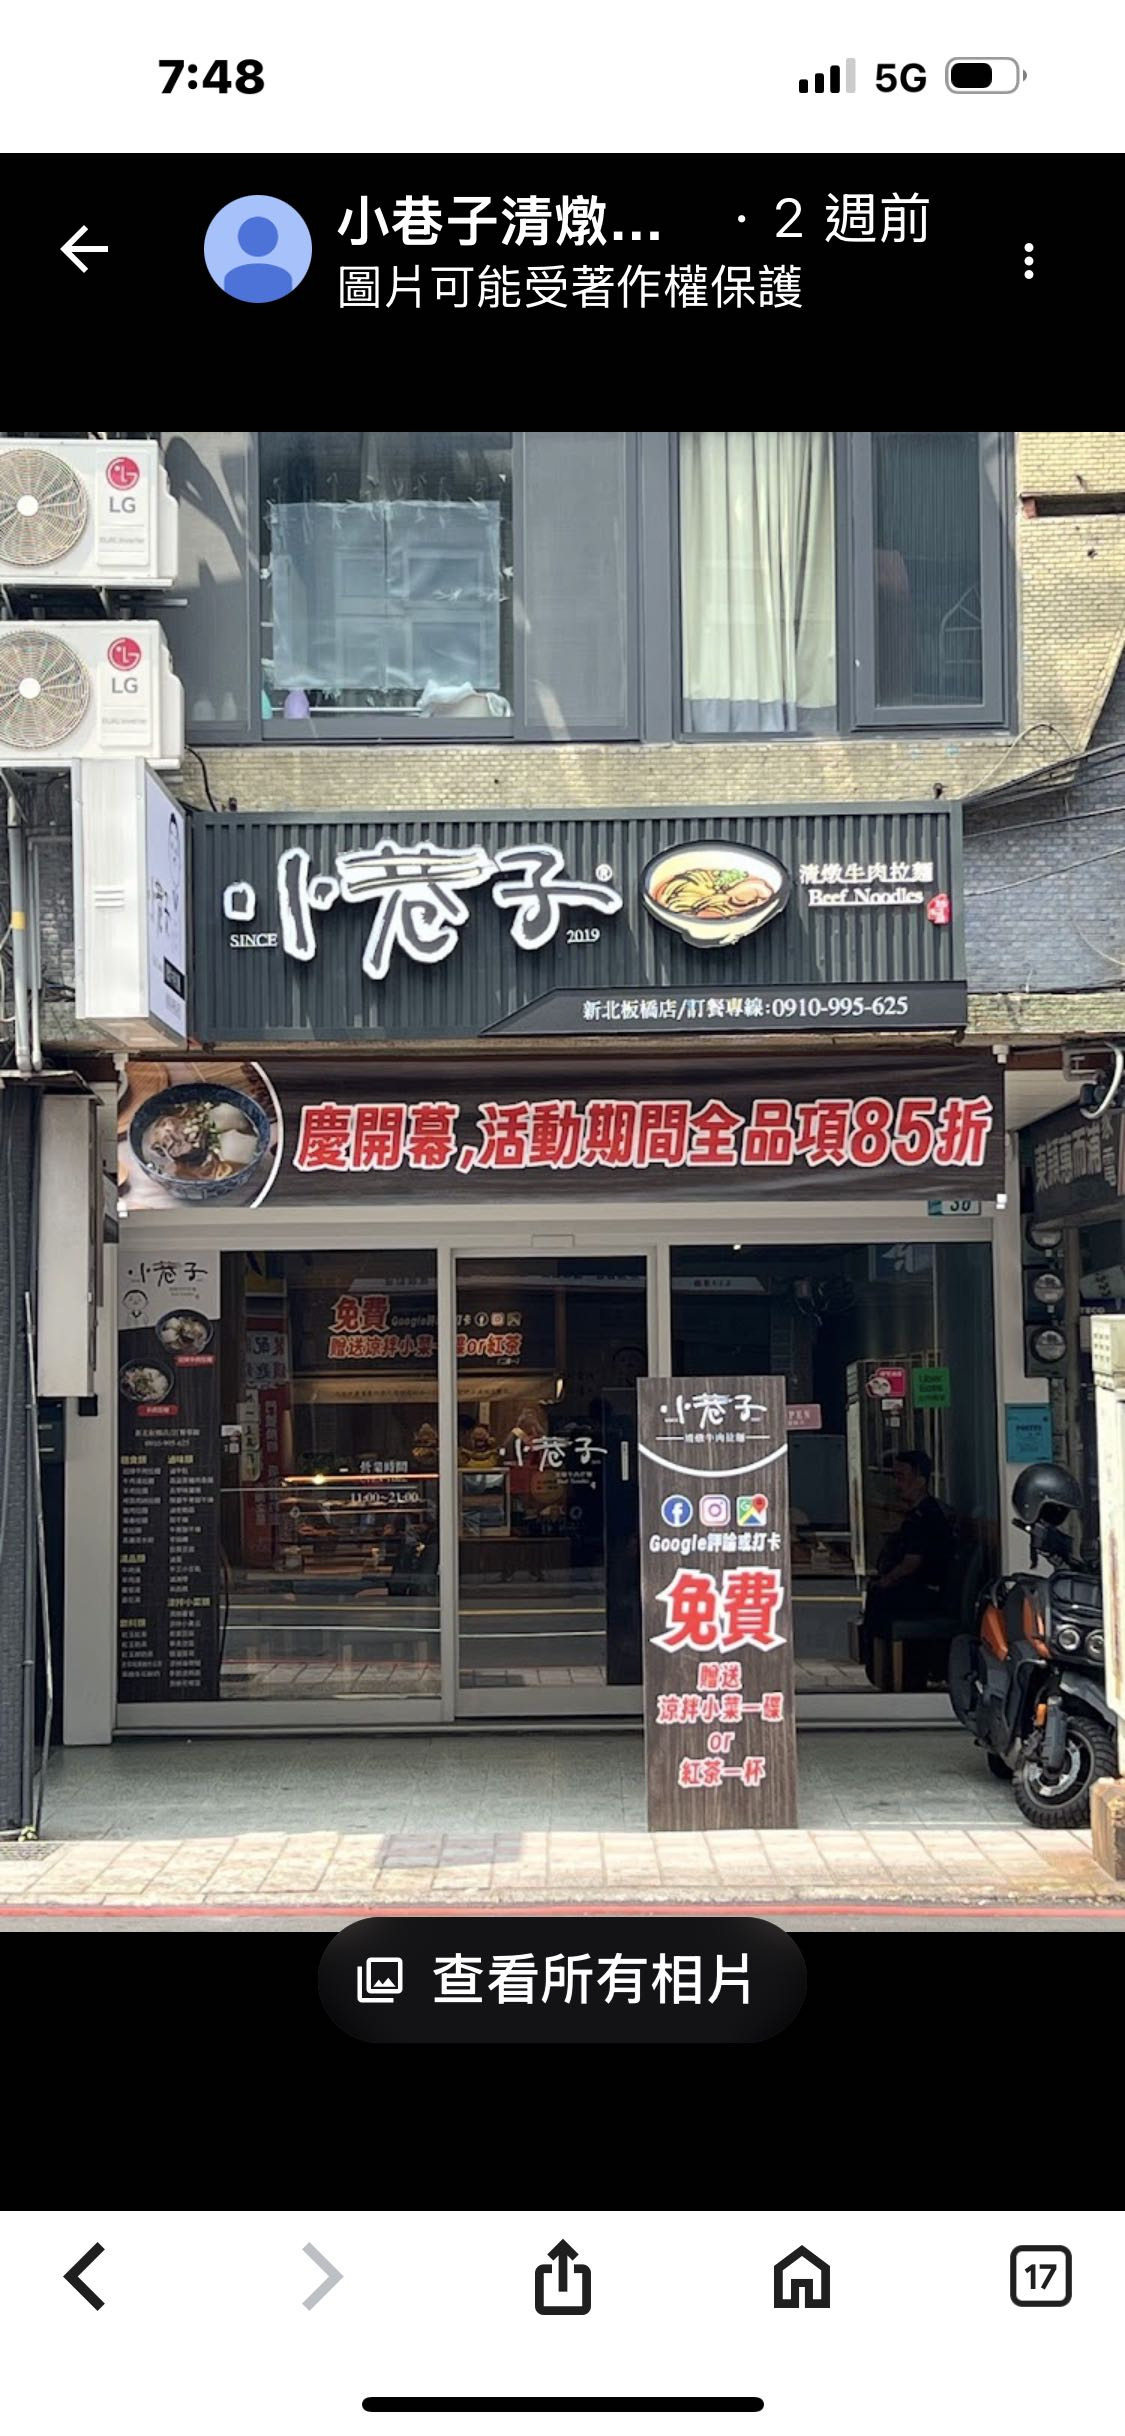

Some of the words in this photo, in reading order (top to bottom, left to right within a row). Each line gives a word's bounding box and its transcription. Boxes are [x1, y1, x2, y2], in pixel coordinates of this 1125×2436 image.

[109, 497, 136, 513] LG
[112, 678, 138, 694] LG
[800, 862, 933, 884] 清燉牛肉拉麵
[808, 889, 849, 906] Beef
[853, 887, 924, 905] Noodles
[224, 839, 623, 980] 小巷子
[230, 933, 278, 948] SINCE
[566, 928, 600, 943] 2019
[294, 1096, 993, 1174] 慶開幕,活動期間全品項85折
[128, 1261, 208, 1287] 小巷子
[329, 1294, 390, 1333] 免費
[660, 1393, 768, 1429] 小巷子
[360, 1460, 408, 1473] 營業時間
[500, 1437, 608, 1472] 小巷子
[350, 1491, 420, 1504] 11:00~21:00
[650, 1532, 781, 1555] Google評論或打卡
[650, 1566, 787, 1653] 免費
[697, 1662, 742, 1691] 贈送
[656, 1693, 783, 1723] 涼拌小菜一碟
[708, 1732, 735, 1753] or
[678, 1756, 765, 1787] 紅茶一杯
